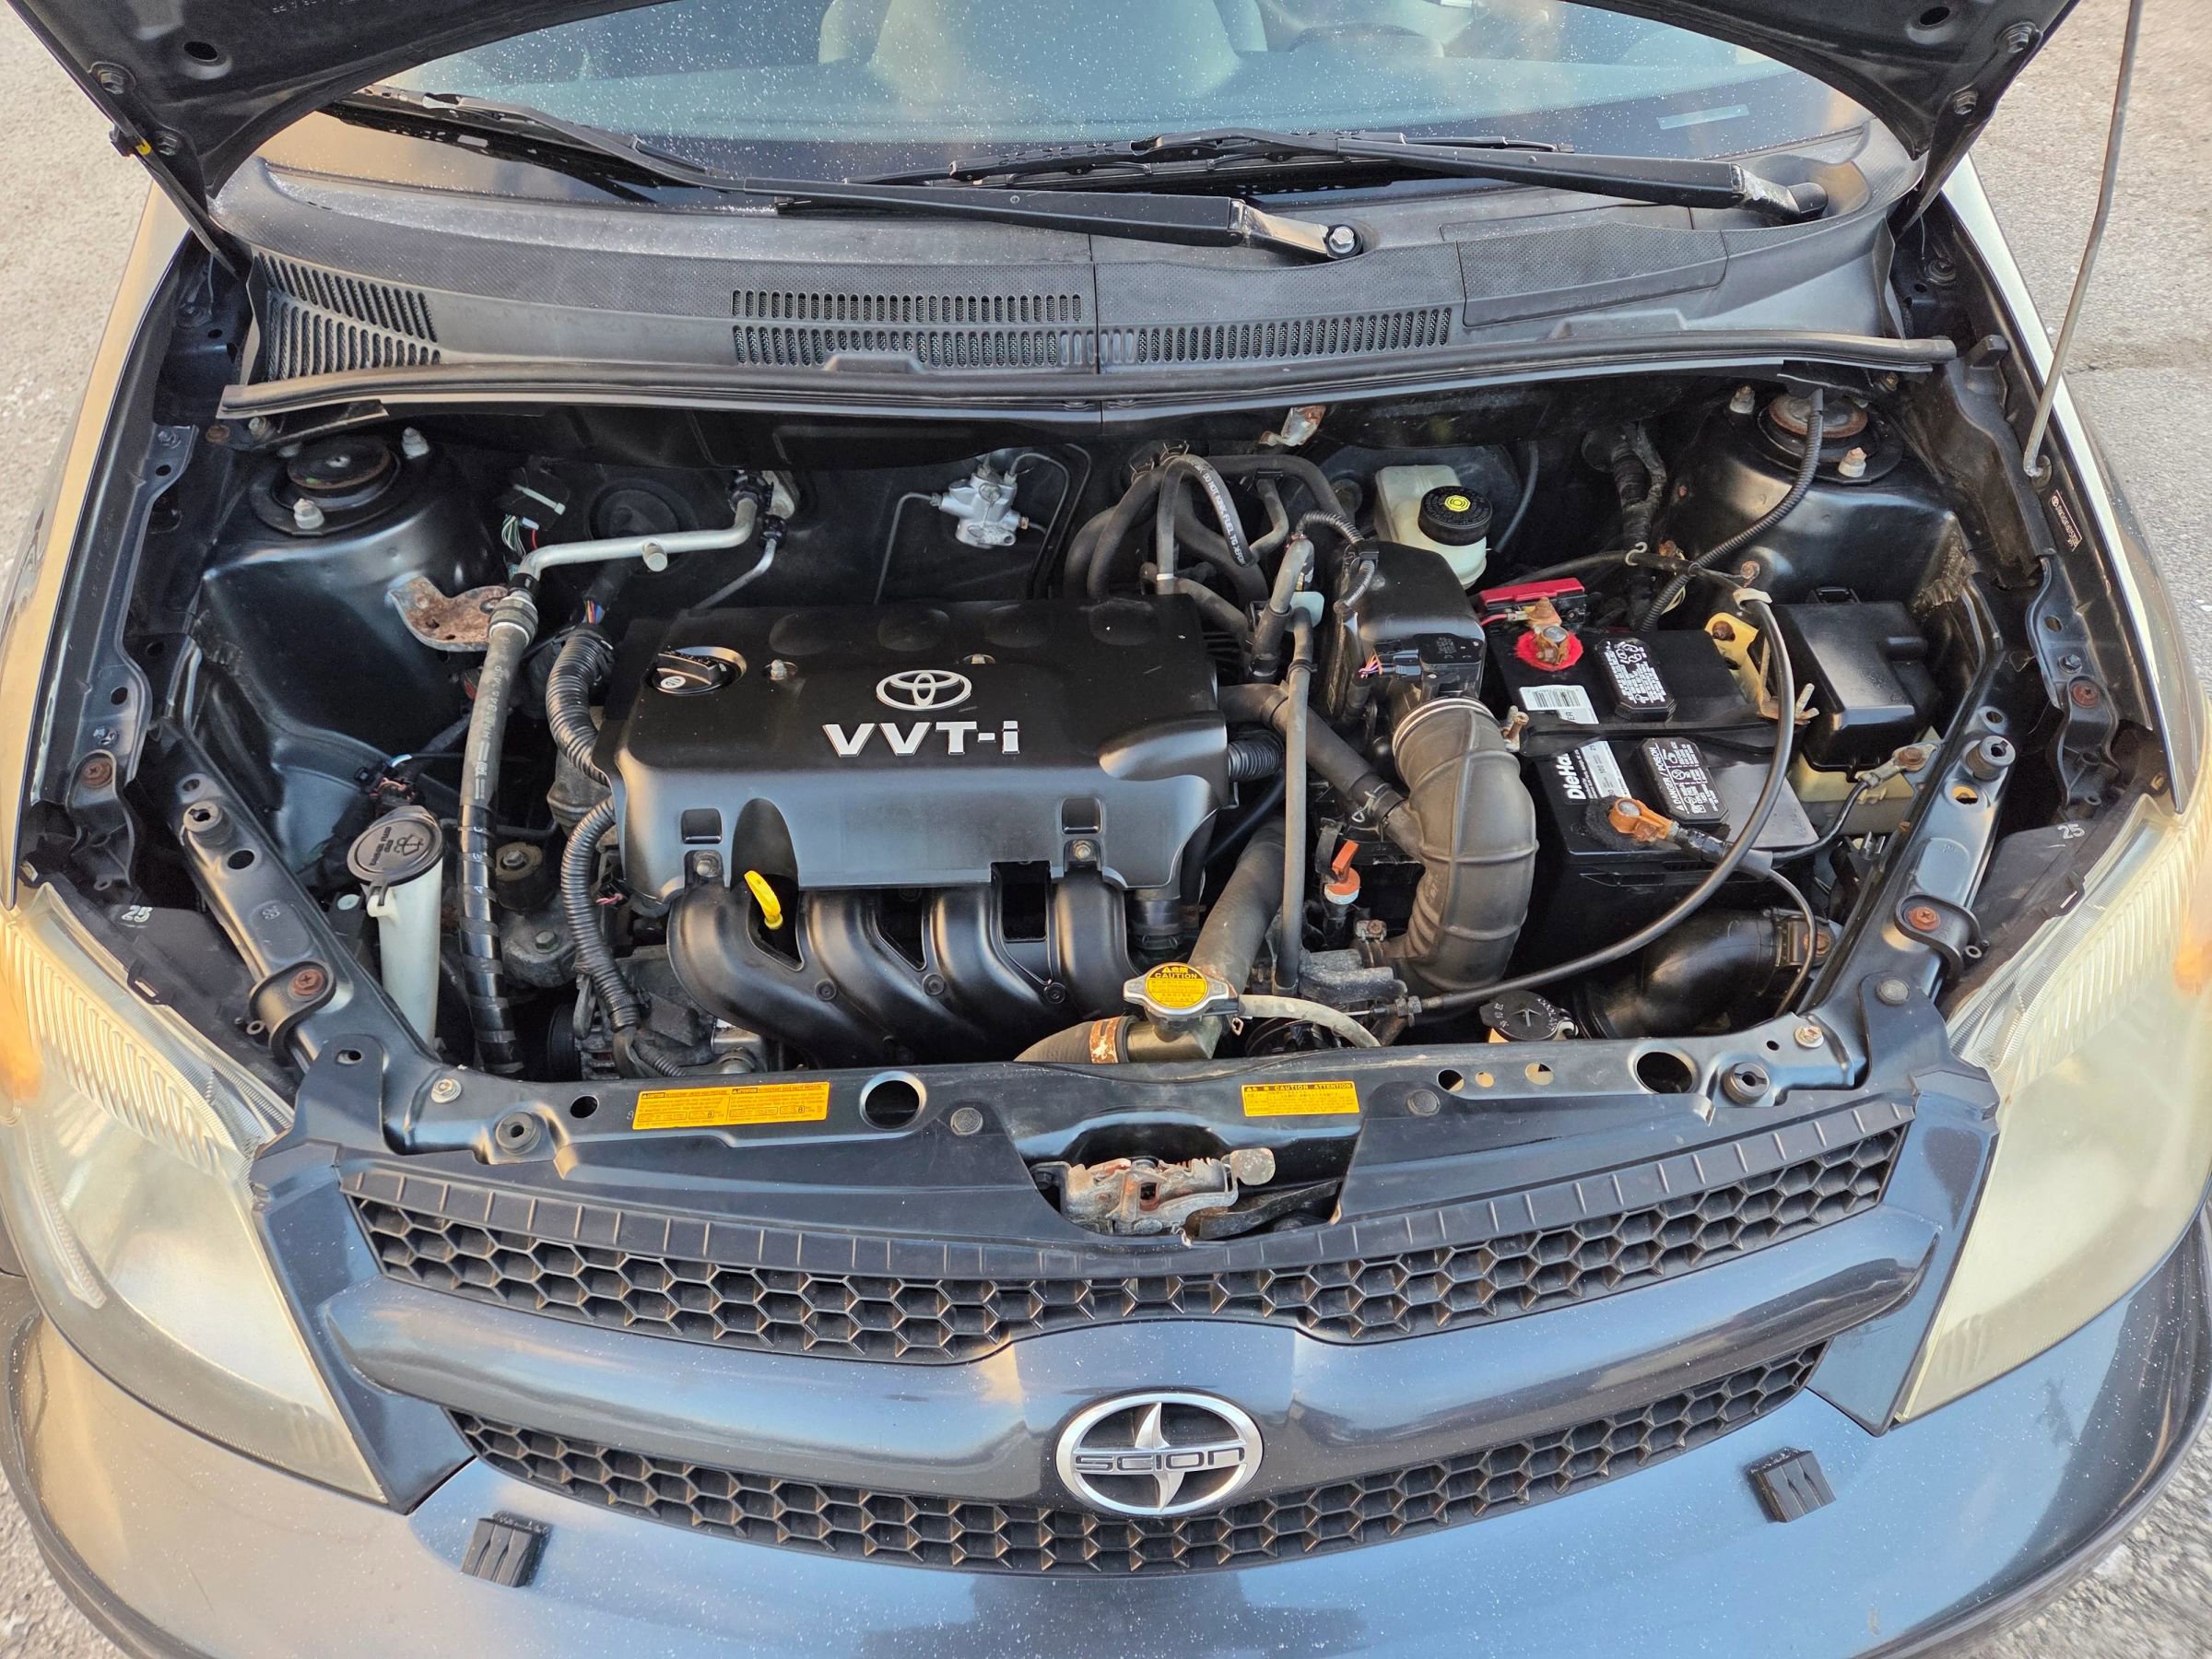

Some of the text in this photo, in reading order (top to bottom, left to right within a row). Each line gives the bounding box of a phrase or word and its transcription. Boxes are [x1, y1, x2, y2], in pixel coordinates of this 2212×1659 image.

[1208, 480, 1219, 495] NOT
[822, 721, 1019, 757] VVT-i
[1649, 747, 1664, 770] POISON
[1557, 752, 1586, 798] DieHa
[1664, 777, 1680, 804] DANGER
[2057, 823, 2086, 840] 25
[121, 904, 153, 923] 25
